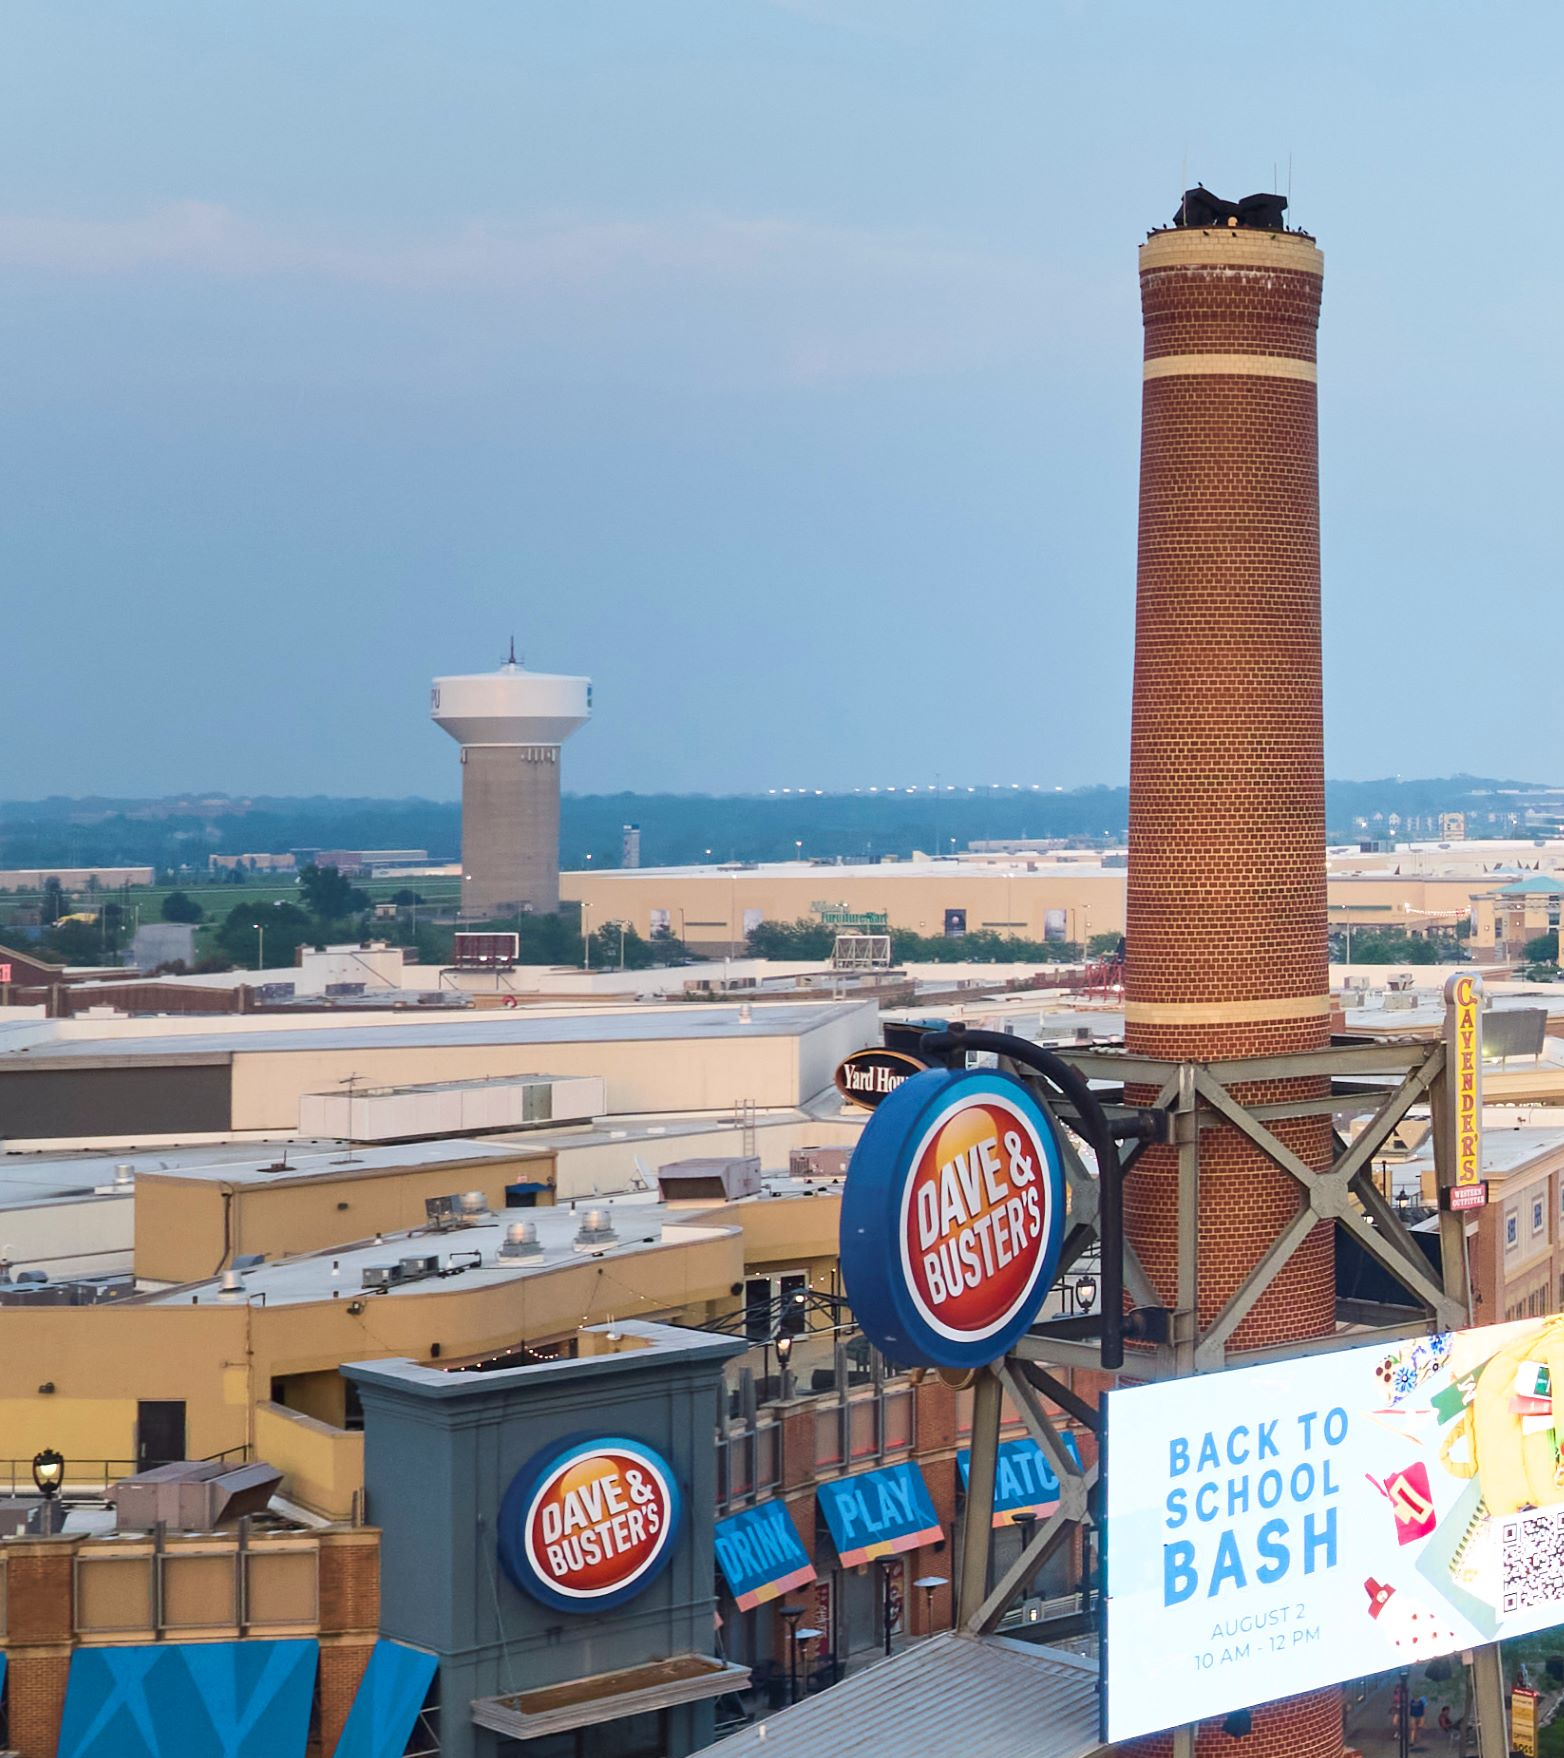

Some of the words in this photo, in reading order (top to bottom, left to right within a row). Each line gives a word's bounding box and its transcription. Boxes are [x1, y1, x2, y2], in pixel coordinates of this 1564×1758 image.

[844, 1064, 874, 1089] Yard
[877, 1066, 909, 1093] Hou
[1457, 978, 1479, 1182] CAVENDER'S
[918, 1136, 1009, 1250] DAVE
[1004, 1131, 1035, 1187] &
[1454, 1188, 1482, 1198] WESTERN
[924, 1186, 1040, 1305] BUSTER'S
[1169, 1418, 1280, 1478] BACK
[1298, 1407, 1348, 1451] TO
[542, 1474, 629, 1544] DAVE
[625, 1470, 655, 1504] &
[836, 1477, 917, 1538] PLAY
[1165, 1459, 1339, 1529] SCHOOL
[546, 1503, 659, 1577] BUSTER'S
[715, 1513, 800, 1584] DRINK
[1164, 1506, 1337, 1608] BASH
[1194, 1652, 1213, 1670] 10
[1220, 1642, 1250, 1664] AM
[1269, 1634, 1286, 1652] 12
[1292, 1626, 1320, 1645] PM
[1211, 1606, 1290, 1640] AUGUST
[1295, 1603, 1305, 1619] 2
